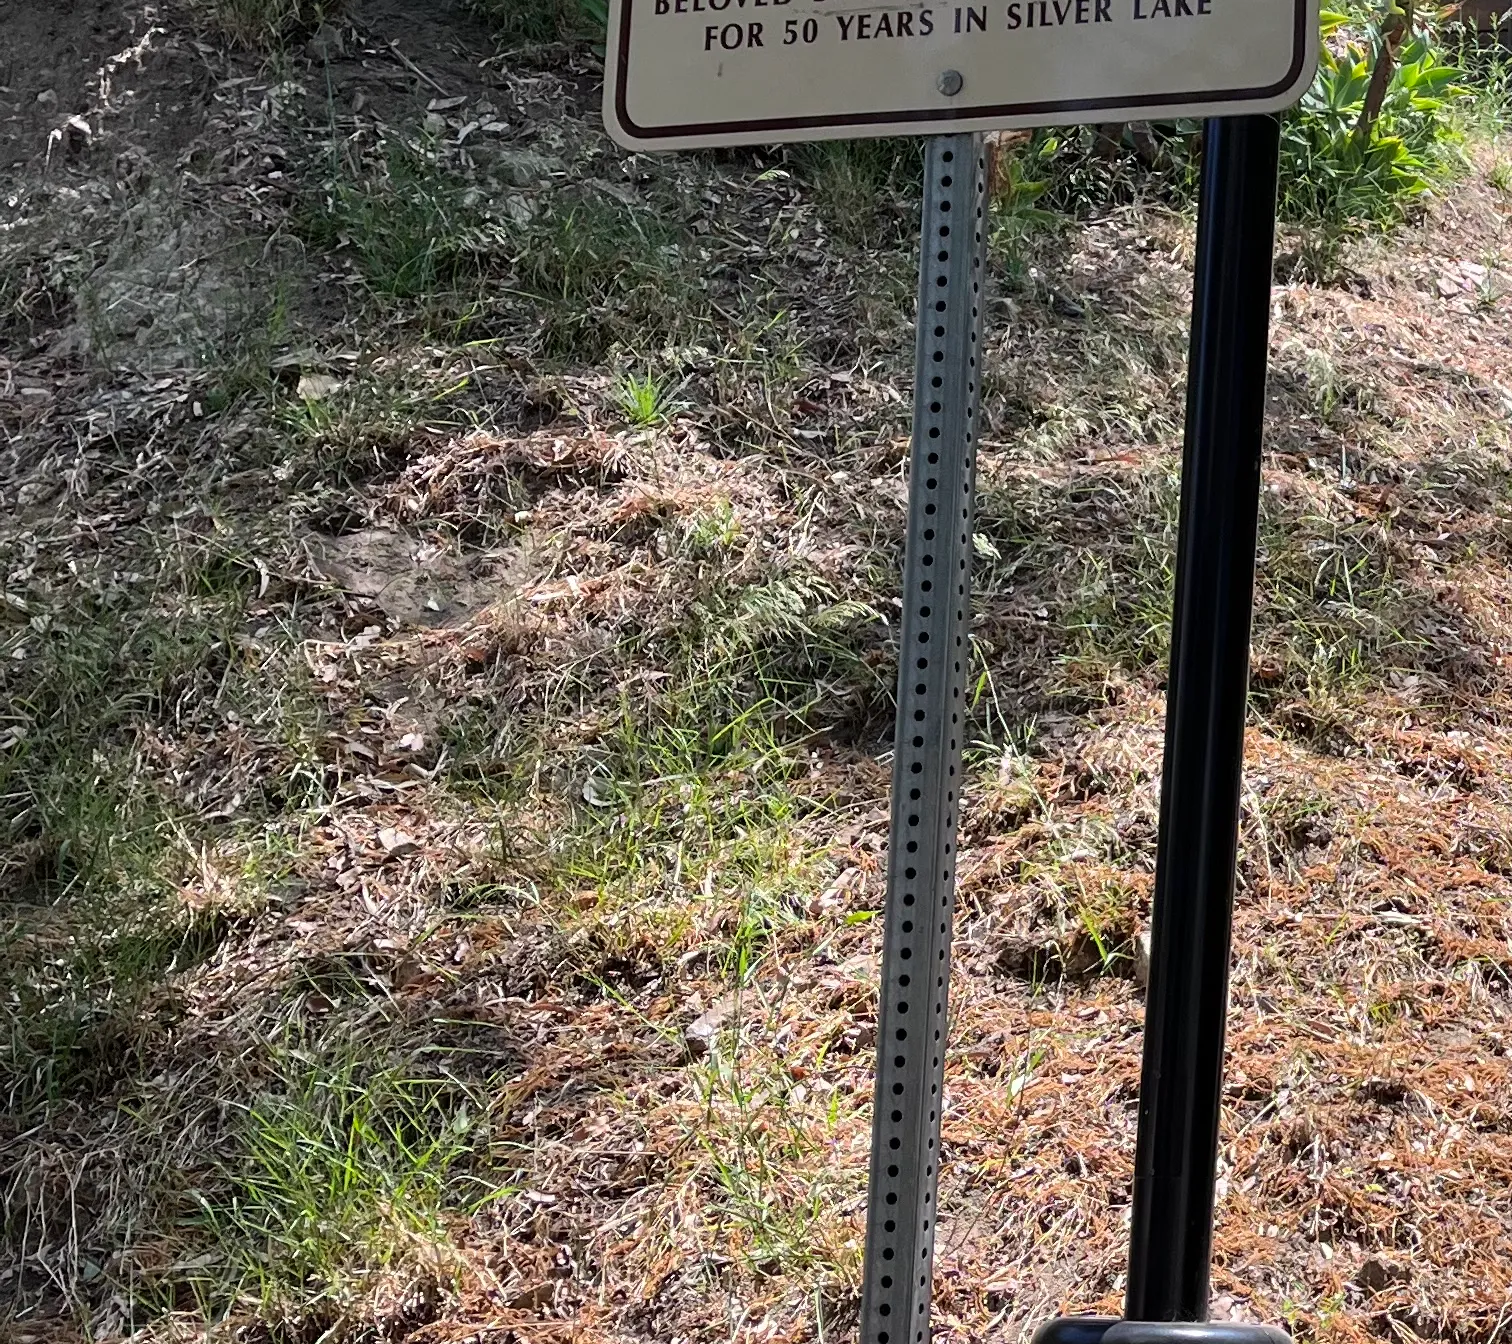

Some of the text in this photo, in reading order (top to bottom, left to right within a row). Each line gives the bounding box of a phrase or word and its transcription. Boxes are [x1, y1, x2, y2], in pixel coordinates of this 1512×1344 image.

[705, 23, 764, 51] FOR
[783, 18, 818, 45] 50
[836, 10, 933, 40] YEARS
[954, 6, 987, 33] IN
